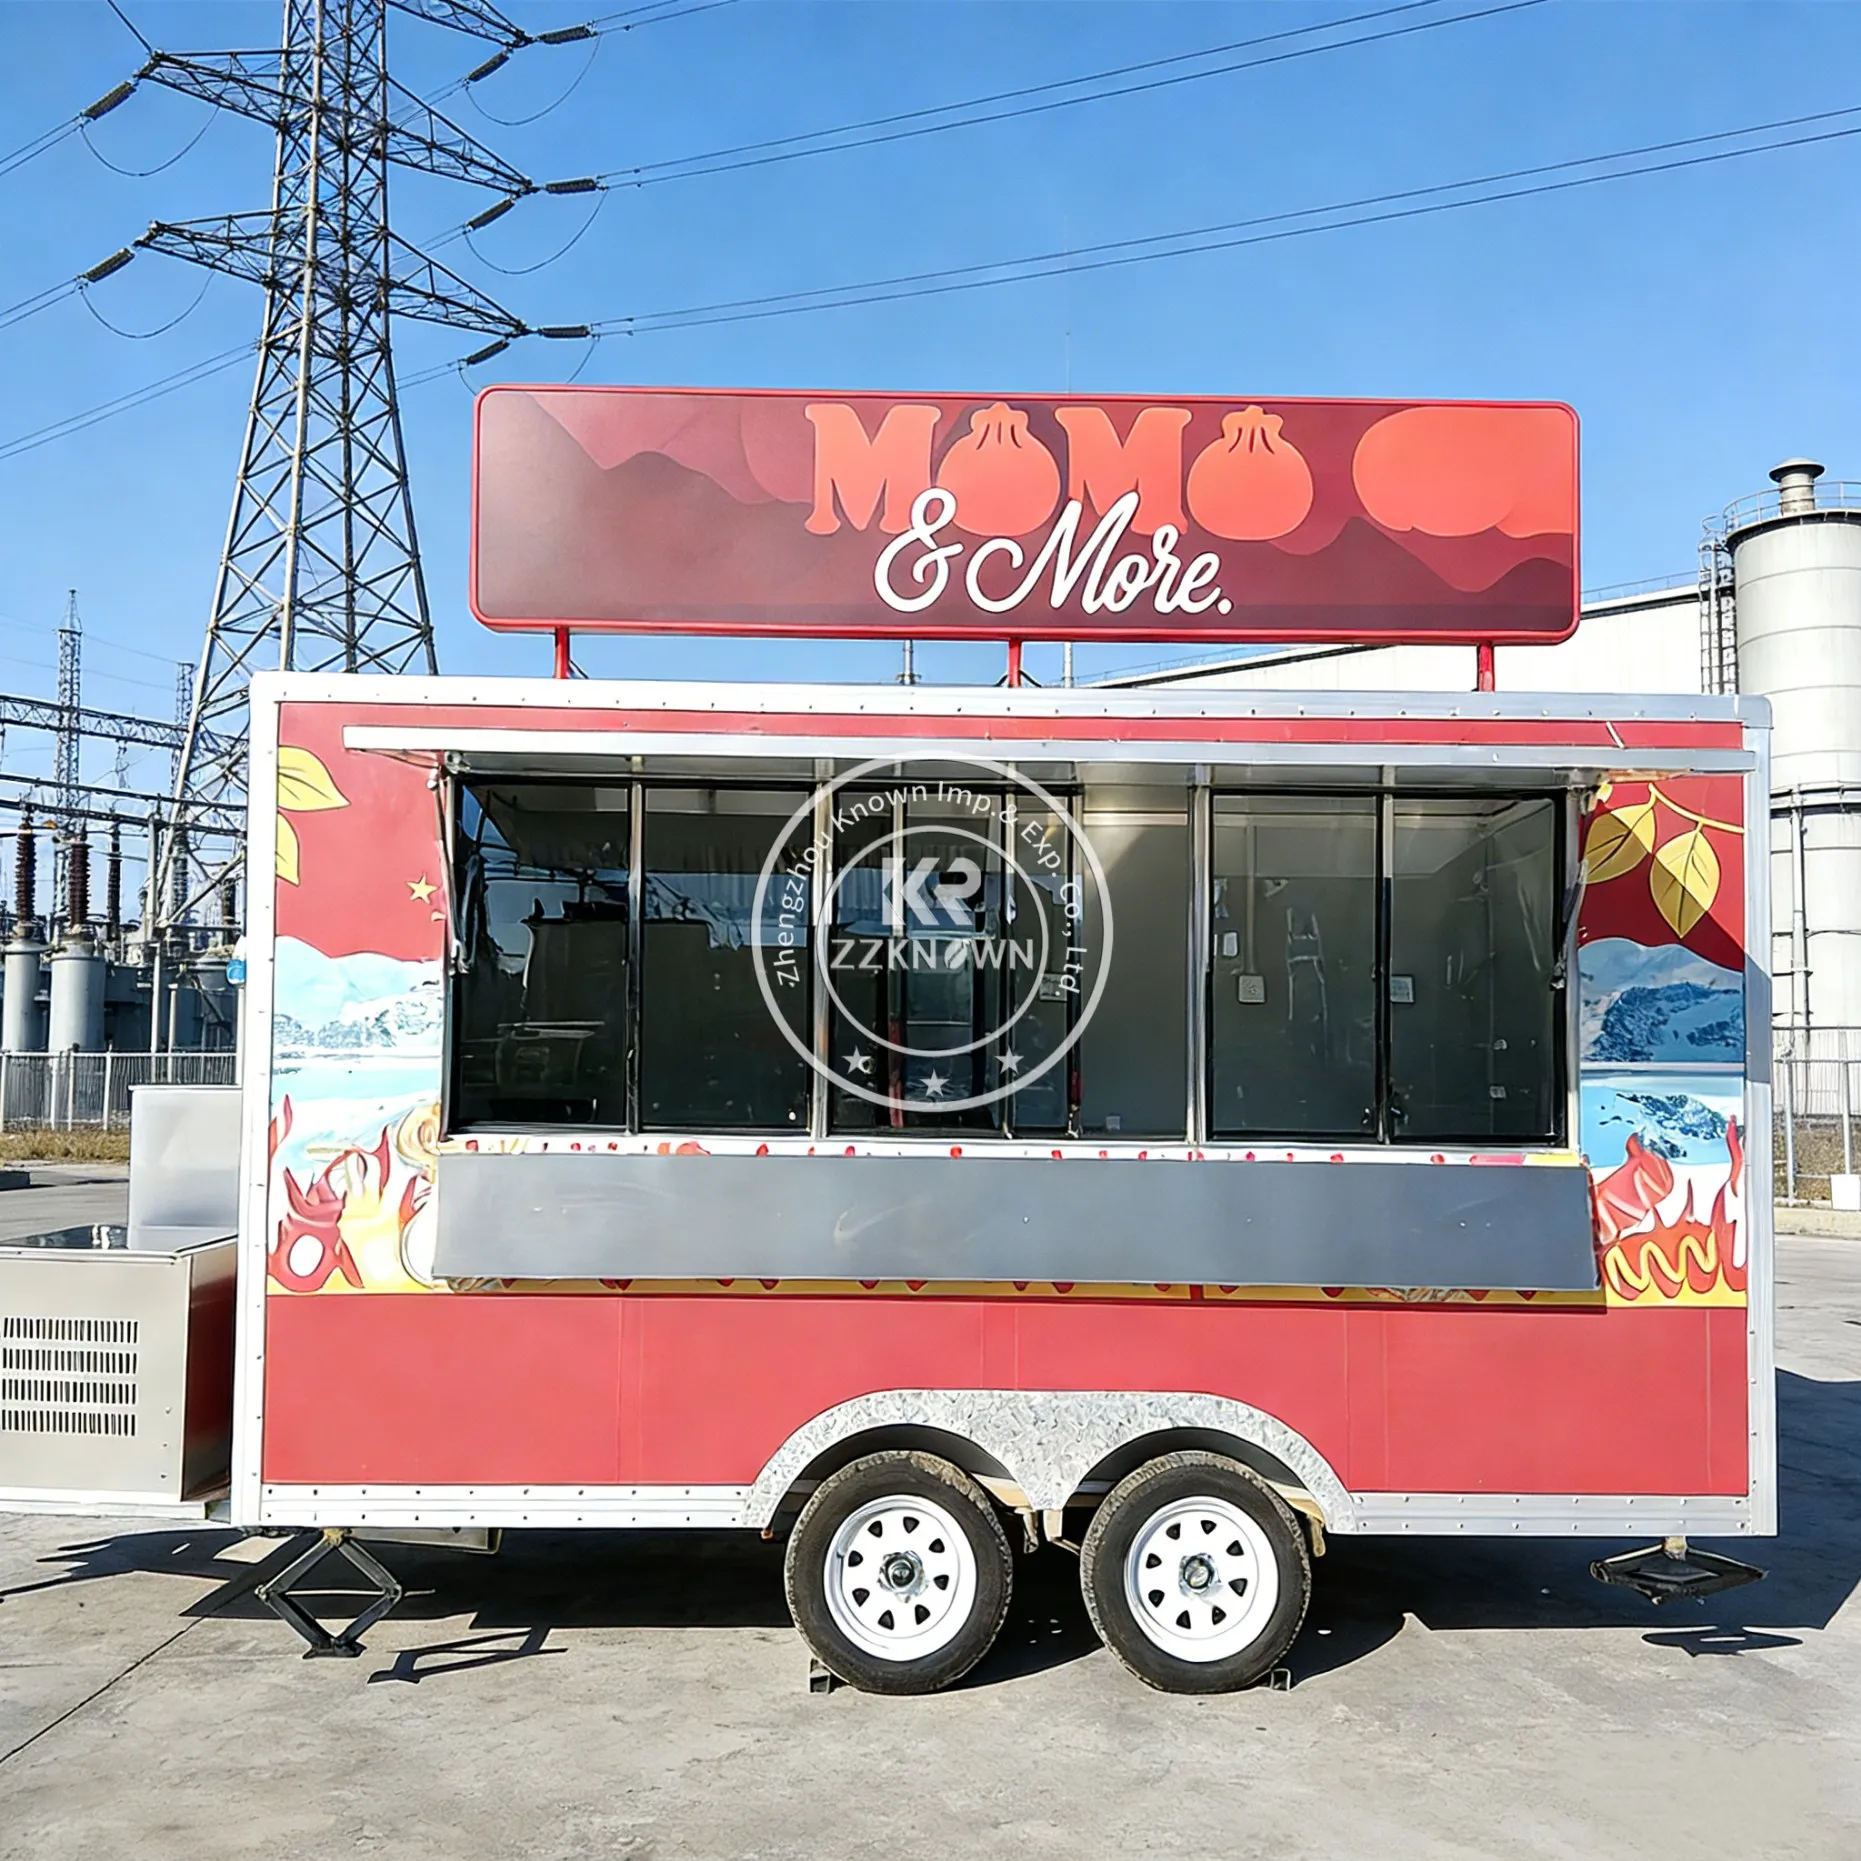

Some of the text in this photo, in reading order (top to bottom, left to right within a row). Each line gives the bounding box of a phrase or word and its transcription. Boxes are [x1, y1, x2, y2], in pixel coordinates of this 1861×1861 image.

[804, 402, 1314, 541] MOMO
[874, 487, 1233, 615] & More.
